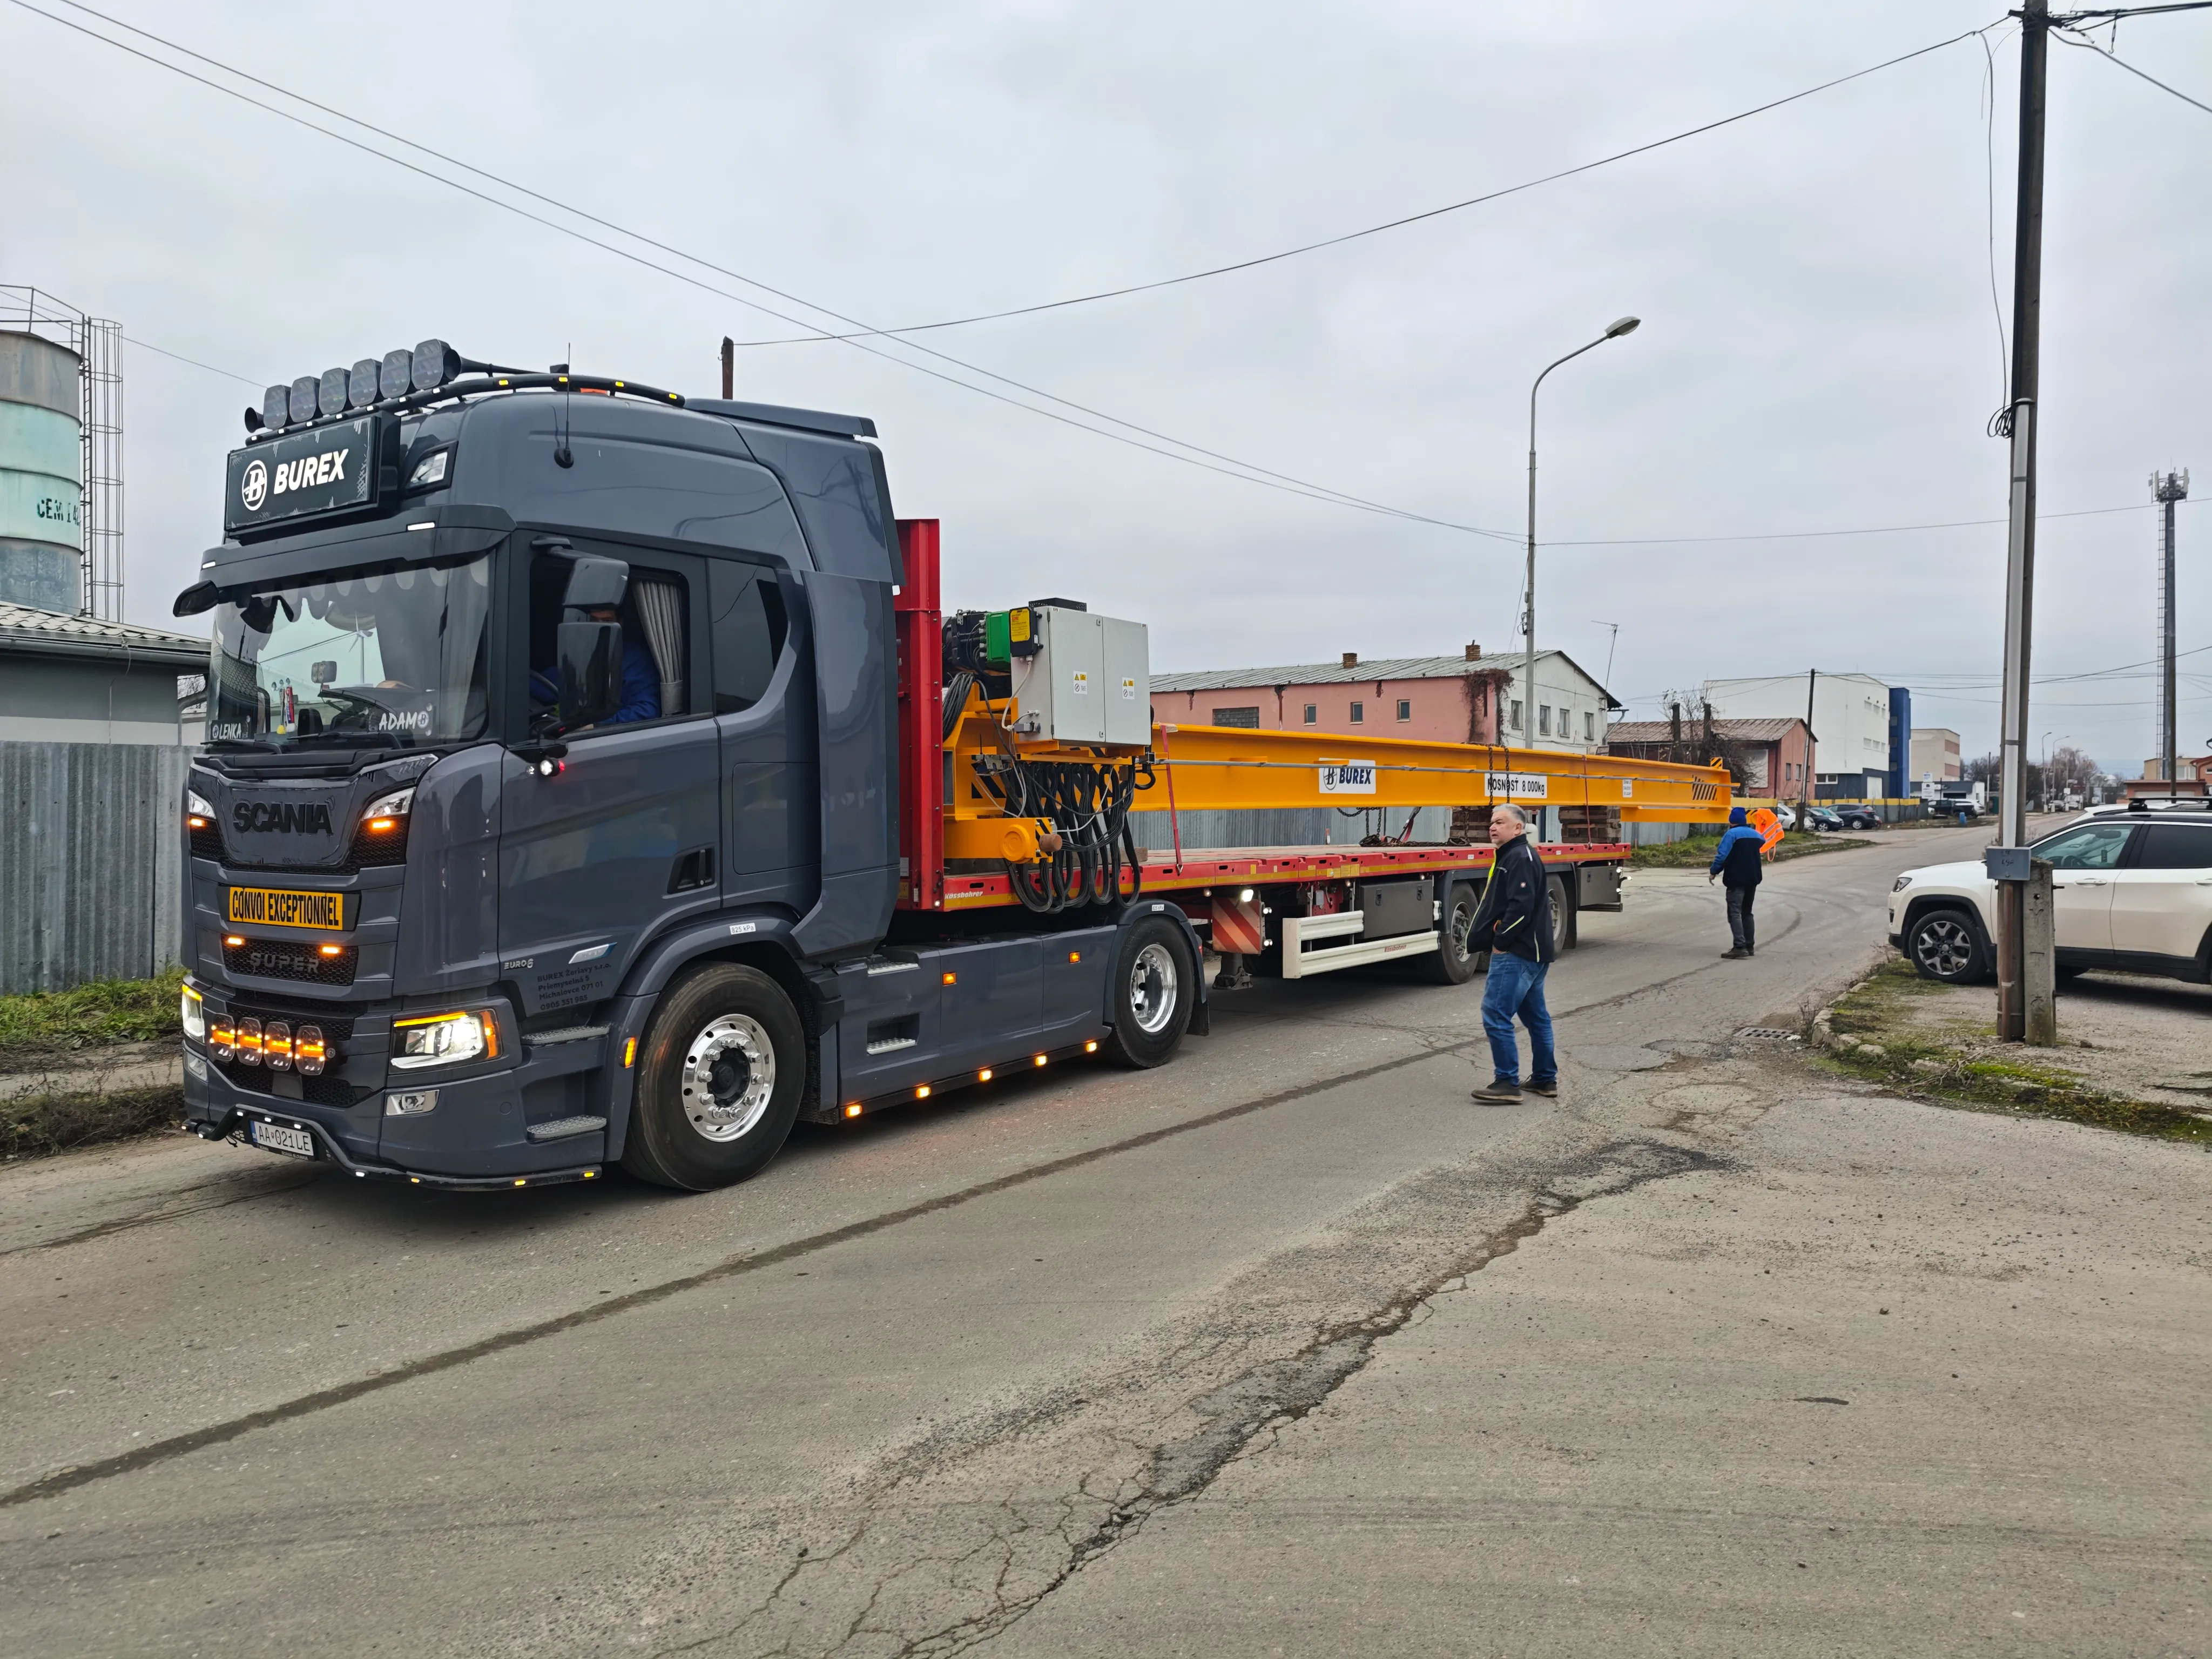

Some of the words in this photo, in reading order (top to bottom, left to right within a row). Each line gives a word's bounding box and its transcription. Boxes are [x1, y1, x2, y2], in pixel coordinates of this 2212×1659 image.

[274, 448, 349, 495] BUREX
[379, 711, 417, 731] ADAM
[219, 723, 241, 740] LENKA
[1339, 767, 1372, 785] BUREX
[1487, 778, 1519, 792] NOSNSŤ
[1522, 780, 1526, 792] 8
[1527, 781, 1545, 795] 000kg
[233, 801, 333, 835] SCANIA
[232, 890, 265, 920] CONVOI
[268, 893, 339, 926] EXCEPTIONNEL
[250, 952, 319, 973] SUPER
[537, 972, 564, 982] BUREX
[538, 976, 584, 991] Priemyselná
[539, 987, 579, 1000] Michalovce
[540, 1001, 560, 1010] 0905
